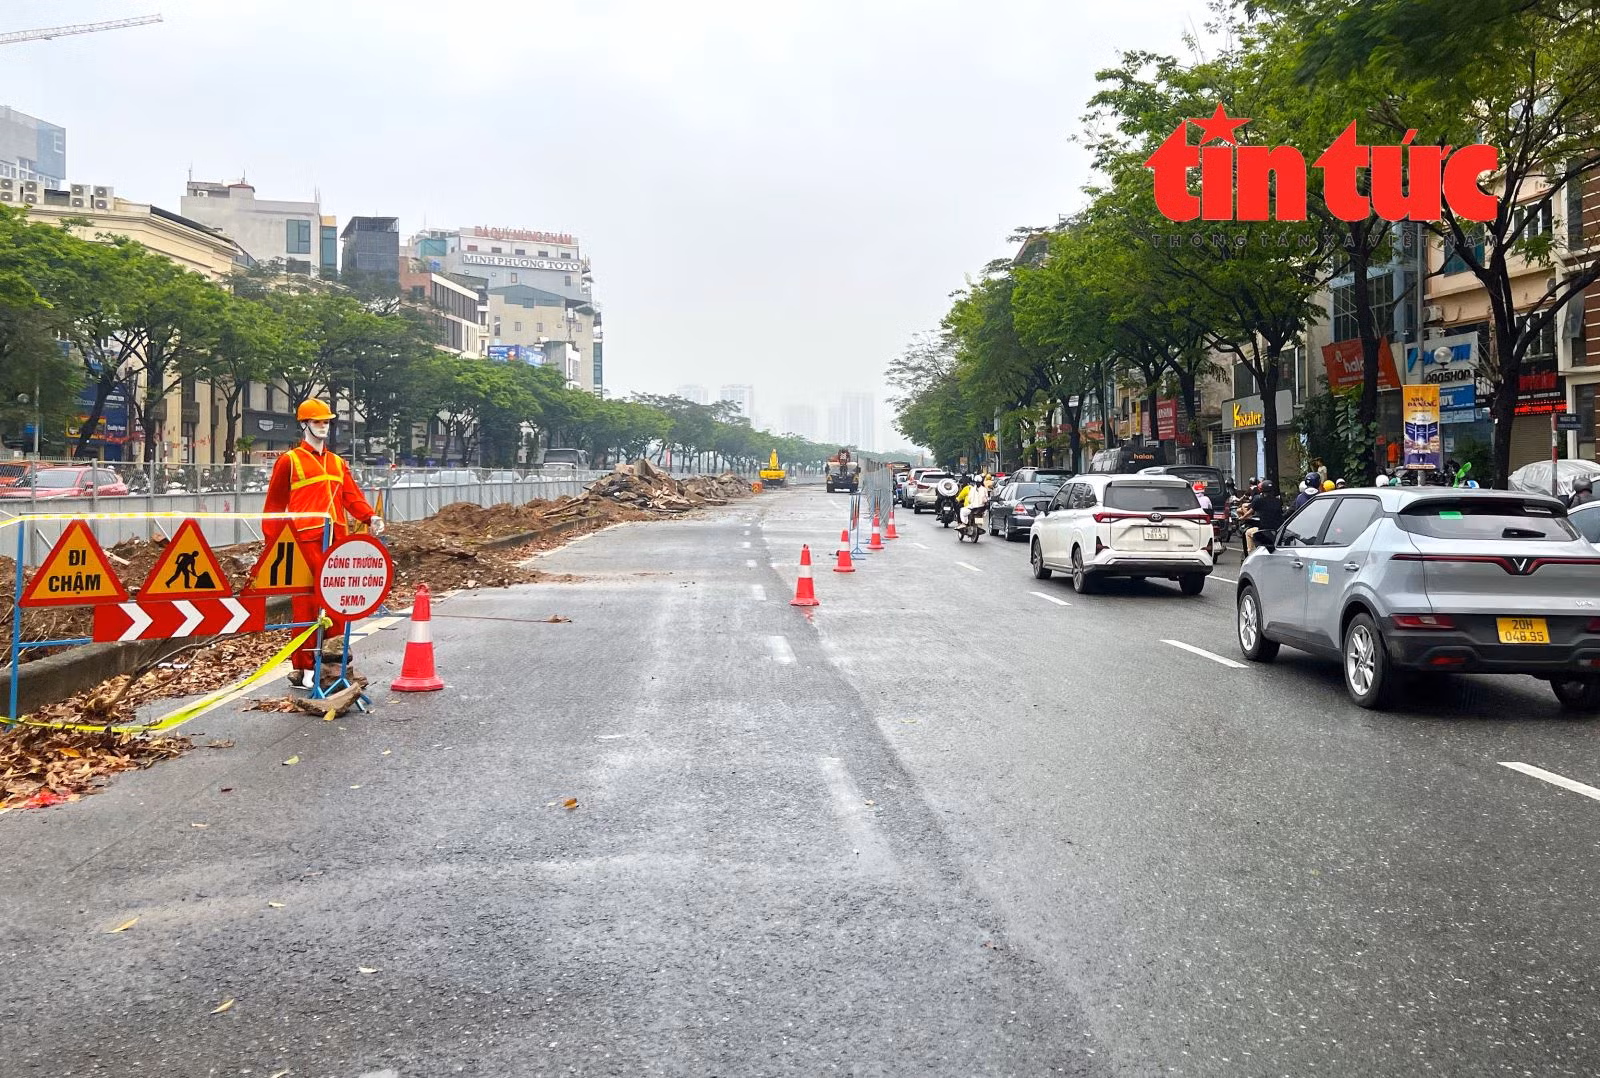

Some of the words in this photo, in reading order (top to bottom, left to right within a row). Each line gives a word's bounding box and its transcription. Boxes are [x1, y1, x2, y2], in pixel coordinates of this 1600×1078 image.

[464, 254, 496, 265] MINH
[68, 549, 87, 566] ĐI
[327, 554, 350, 569] CÔNG
[48, 571, 101, 594] CHẬM
[347, 576, 361, 587] THI
[361, 573, 385, 587] CÔNG
[340, 595, 366, 607] 5KM/h
[1511, 619, 1534, 630] 20H
[1505, 631, 1544, 642] 048.95
